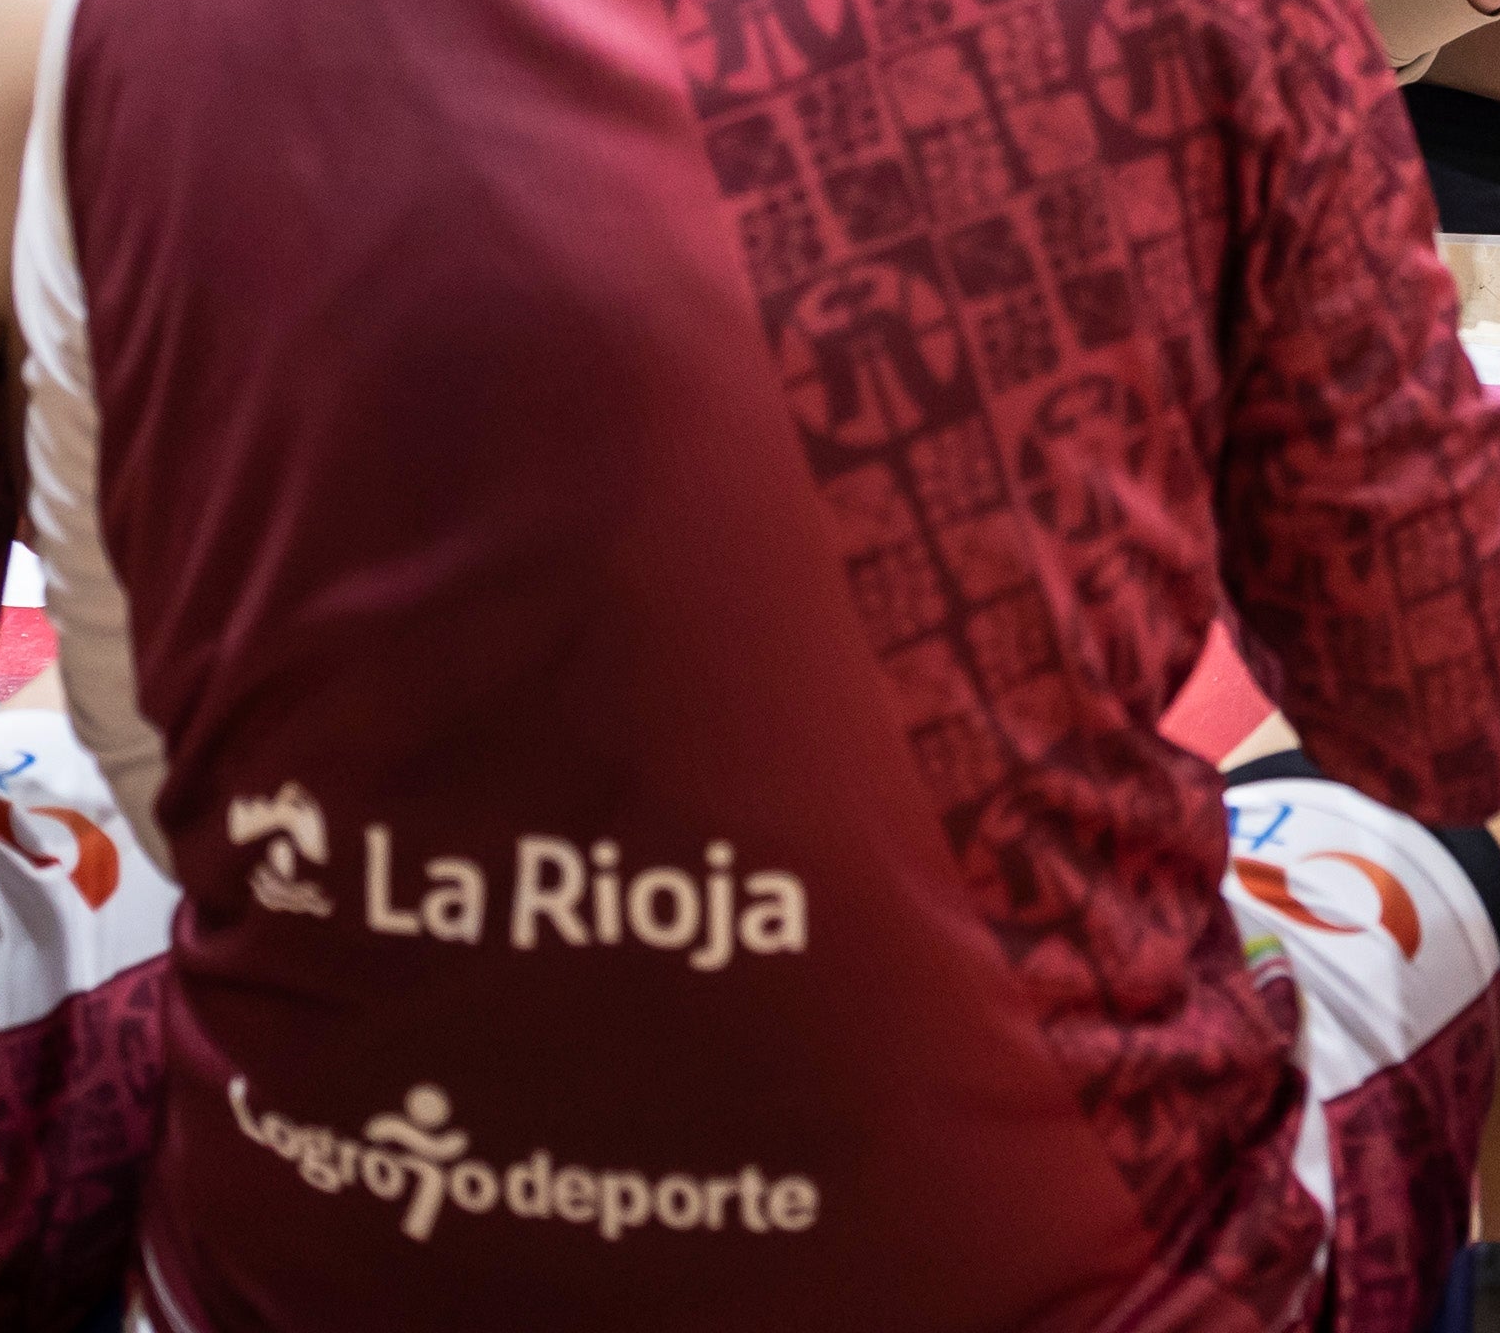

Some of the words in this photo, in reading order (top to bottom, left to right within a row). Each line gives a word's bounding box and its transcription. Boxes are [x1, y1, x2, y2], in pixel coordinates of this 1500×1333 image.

[363, 821, 488, 946] La
[509, 832, 810, 973] Rioja
[503, 1145, 822, 1242] deporte
